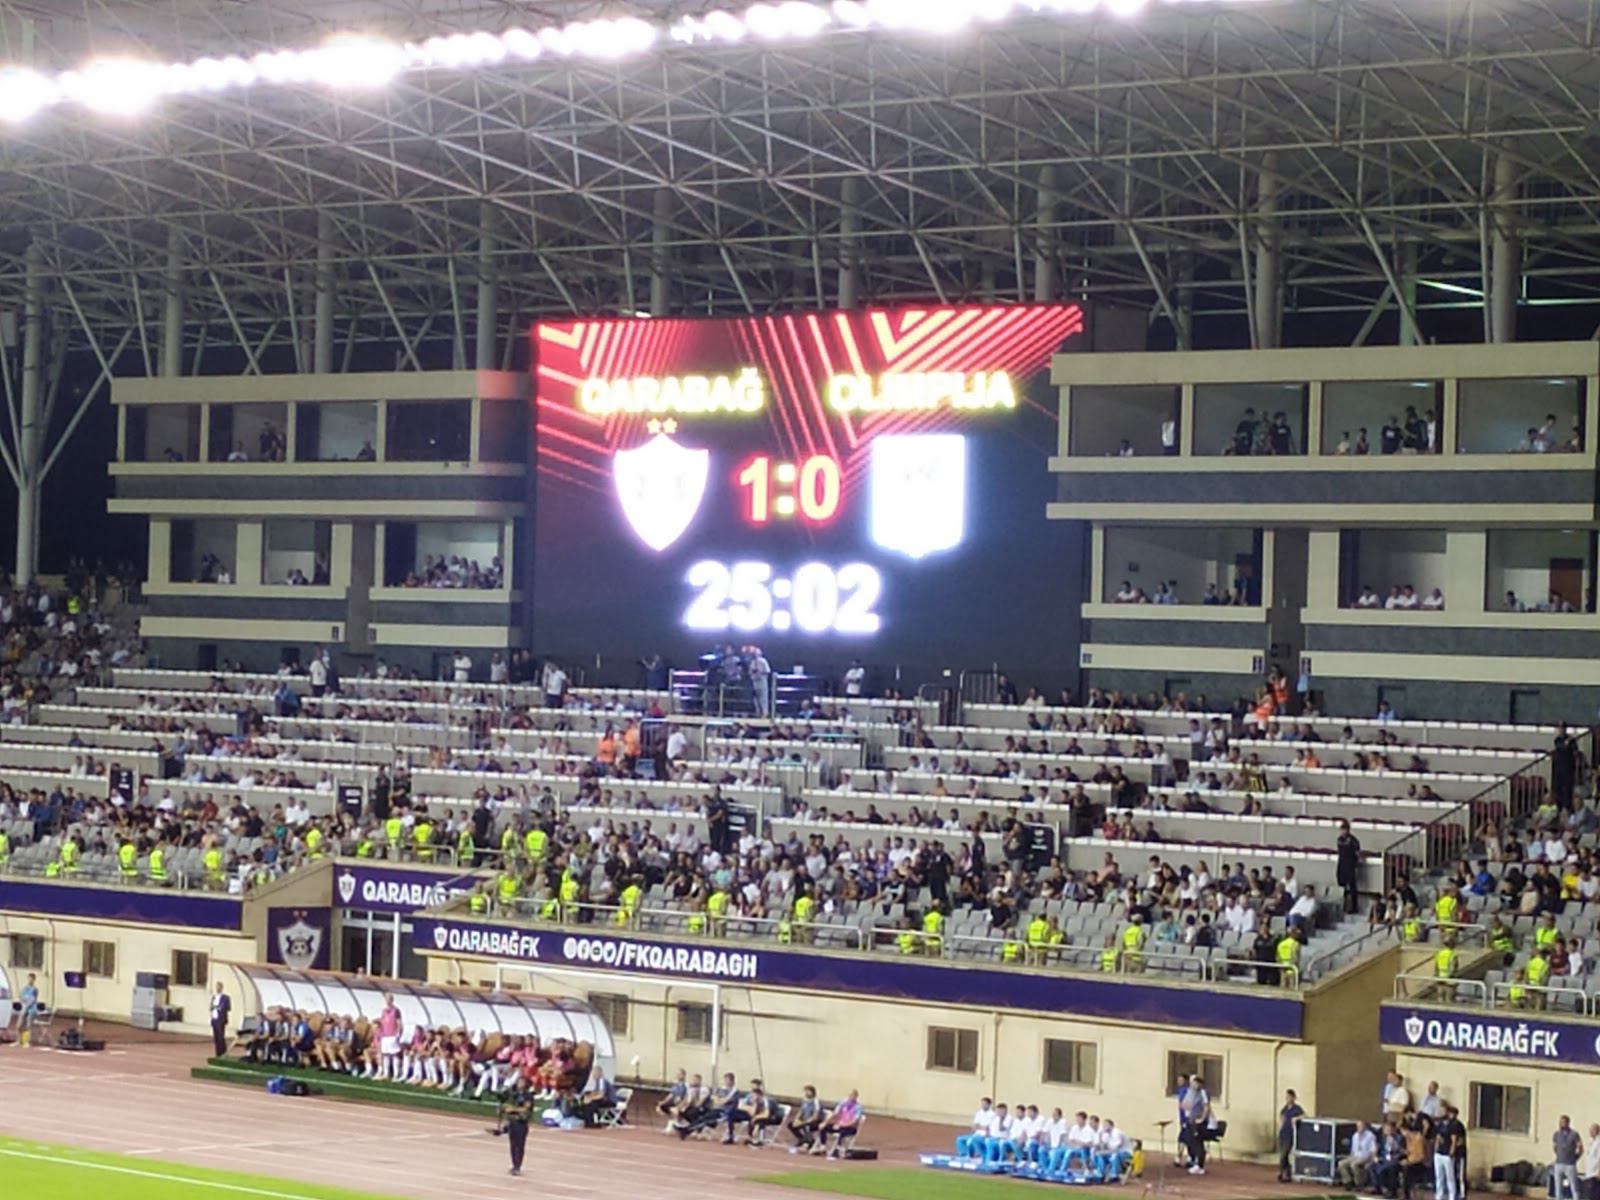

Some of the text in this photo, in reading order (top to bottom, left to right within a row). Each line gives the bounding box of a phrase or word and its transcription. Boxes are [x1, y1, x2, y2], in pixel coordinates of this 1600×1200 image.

[581, 367, 764, 413] QARABAĞ
[738, 456, 841, 522] 1:0
[684, 561, 882, 632] 25:02
